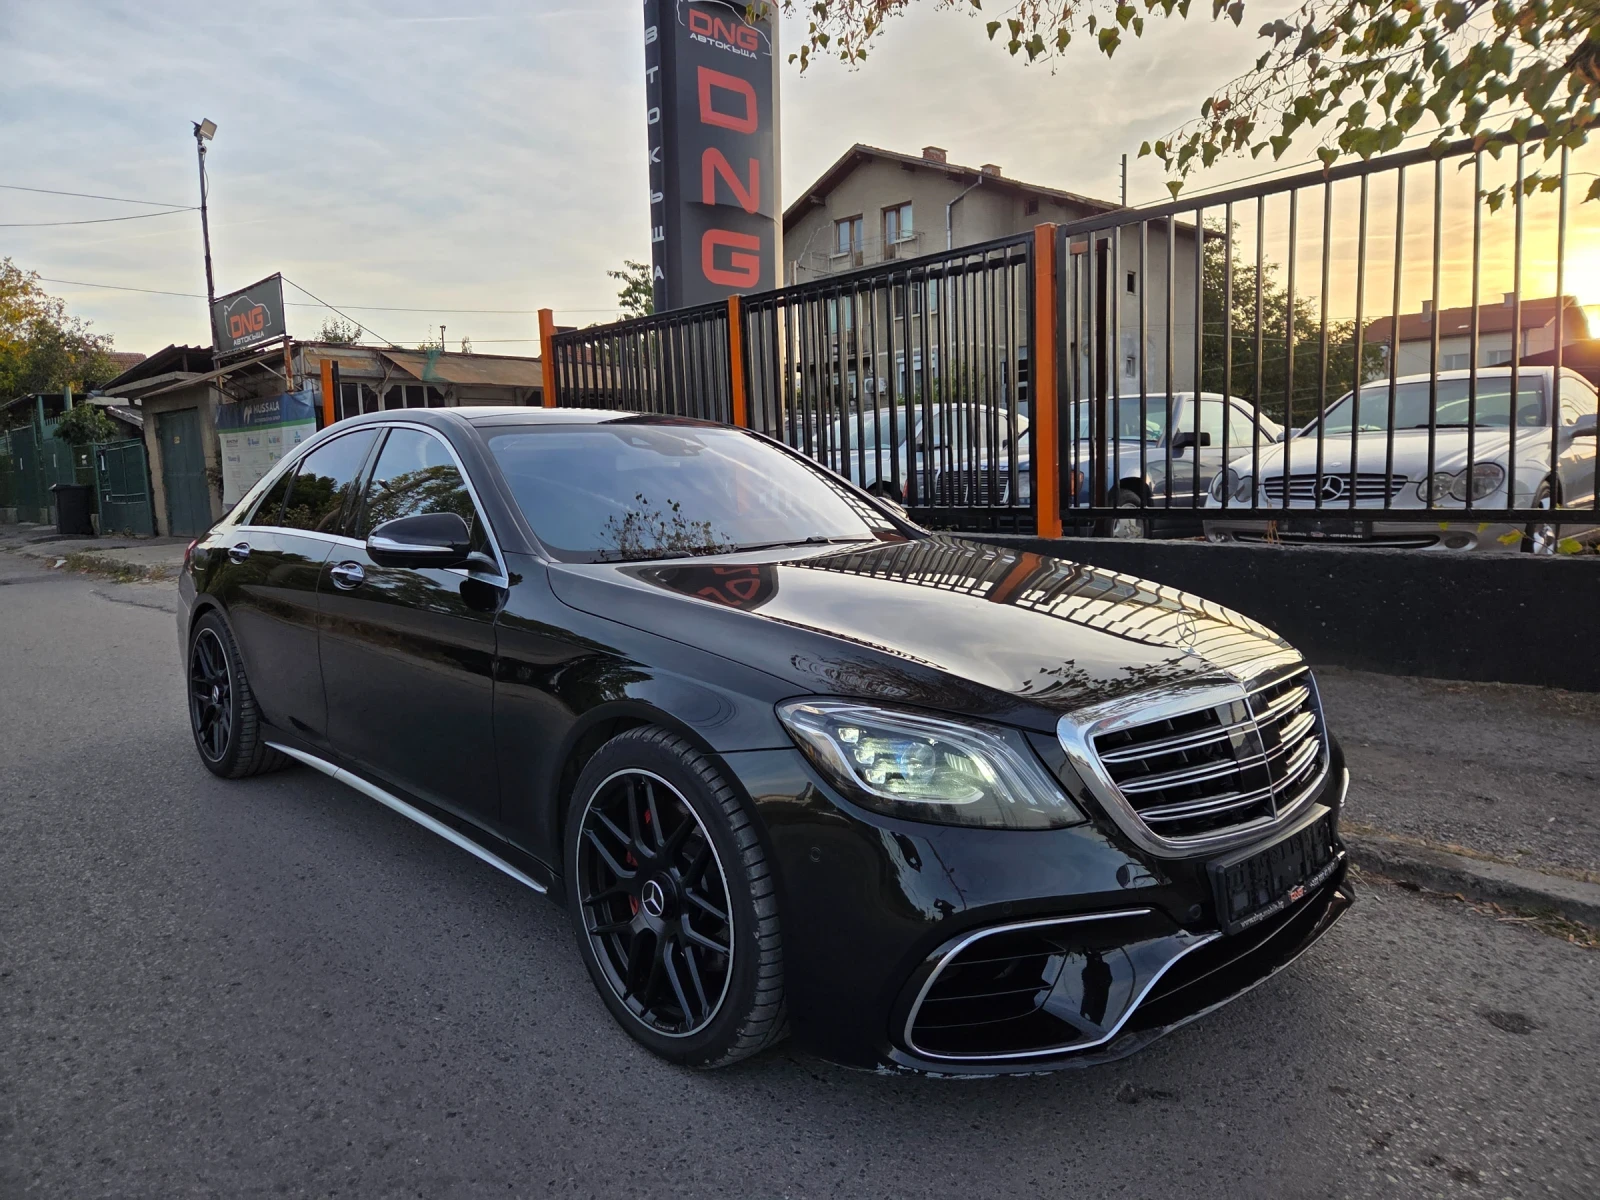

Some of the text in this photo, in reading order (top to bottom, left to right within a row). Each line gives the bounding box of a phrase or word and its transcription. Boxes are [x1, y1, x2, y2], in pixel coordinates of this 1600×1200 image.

[689, 8, 759, 51] DNG
[689, 32, 758, 60] АВТОКЪЩА
[644, 0, 665, 281] ВТОКЪЩА
[697, 65, 760, 288] DNG
[230, 306, 264, 339] DNG
